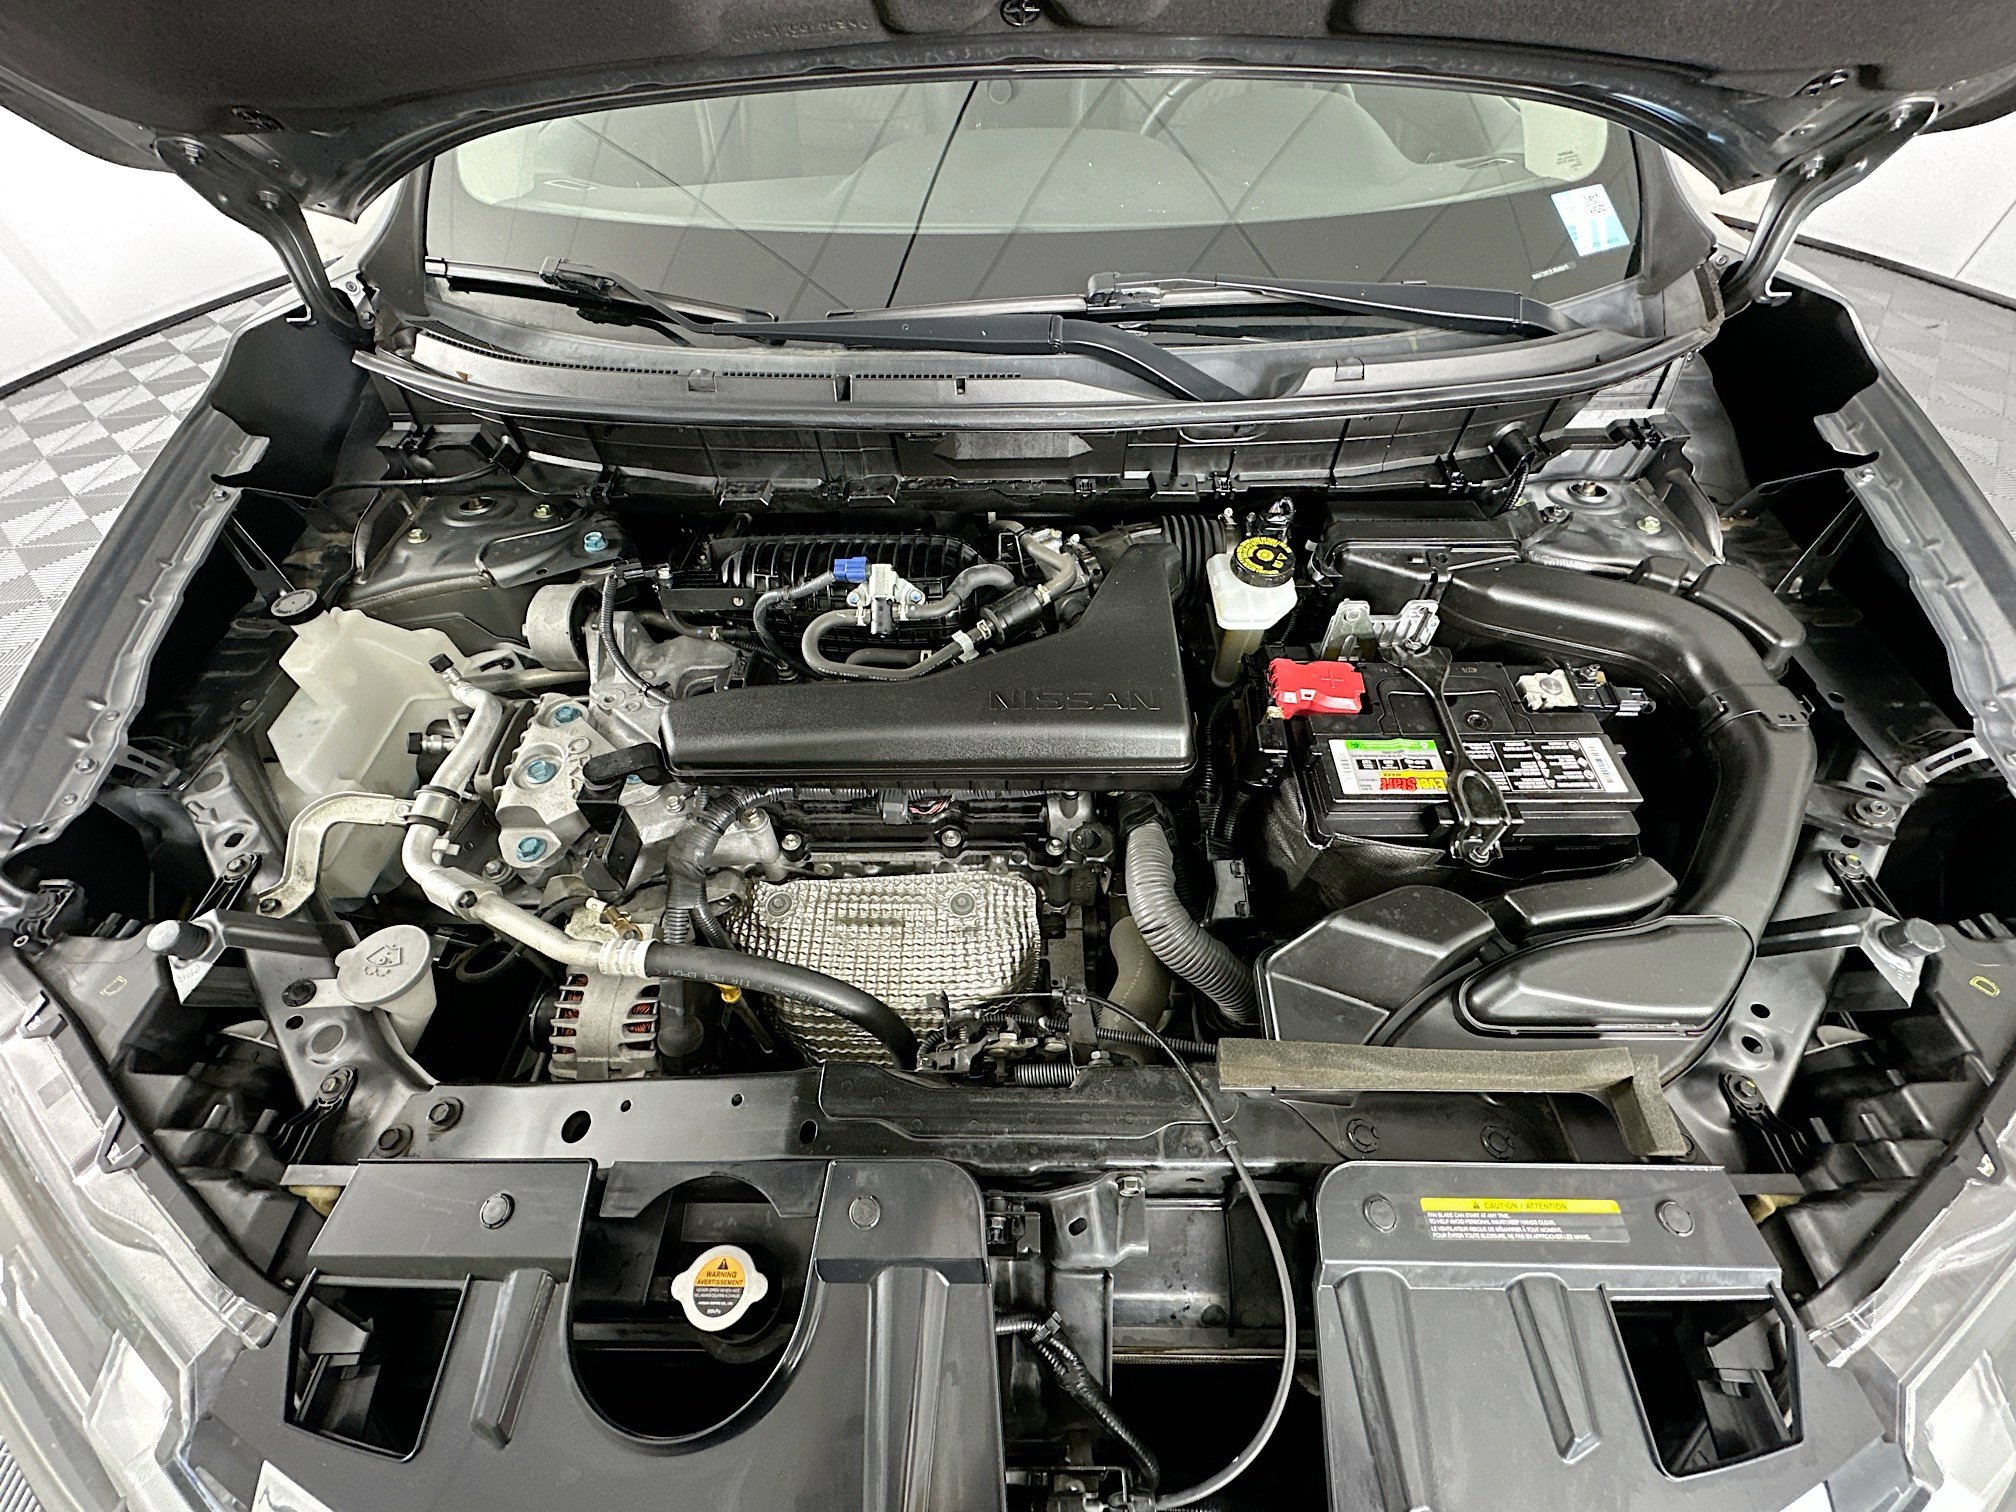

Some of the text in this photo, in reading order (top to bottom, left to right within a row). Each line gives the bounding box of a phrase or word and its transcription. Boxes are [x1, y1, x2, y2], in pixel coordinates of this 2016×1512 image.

[989, 690, 1160, 710] NISSAN
[1484, 1202, 1519, 1210] CAUTION
[1526, 1202, 1568, 1210] ATTENTION
